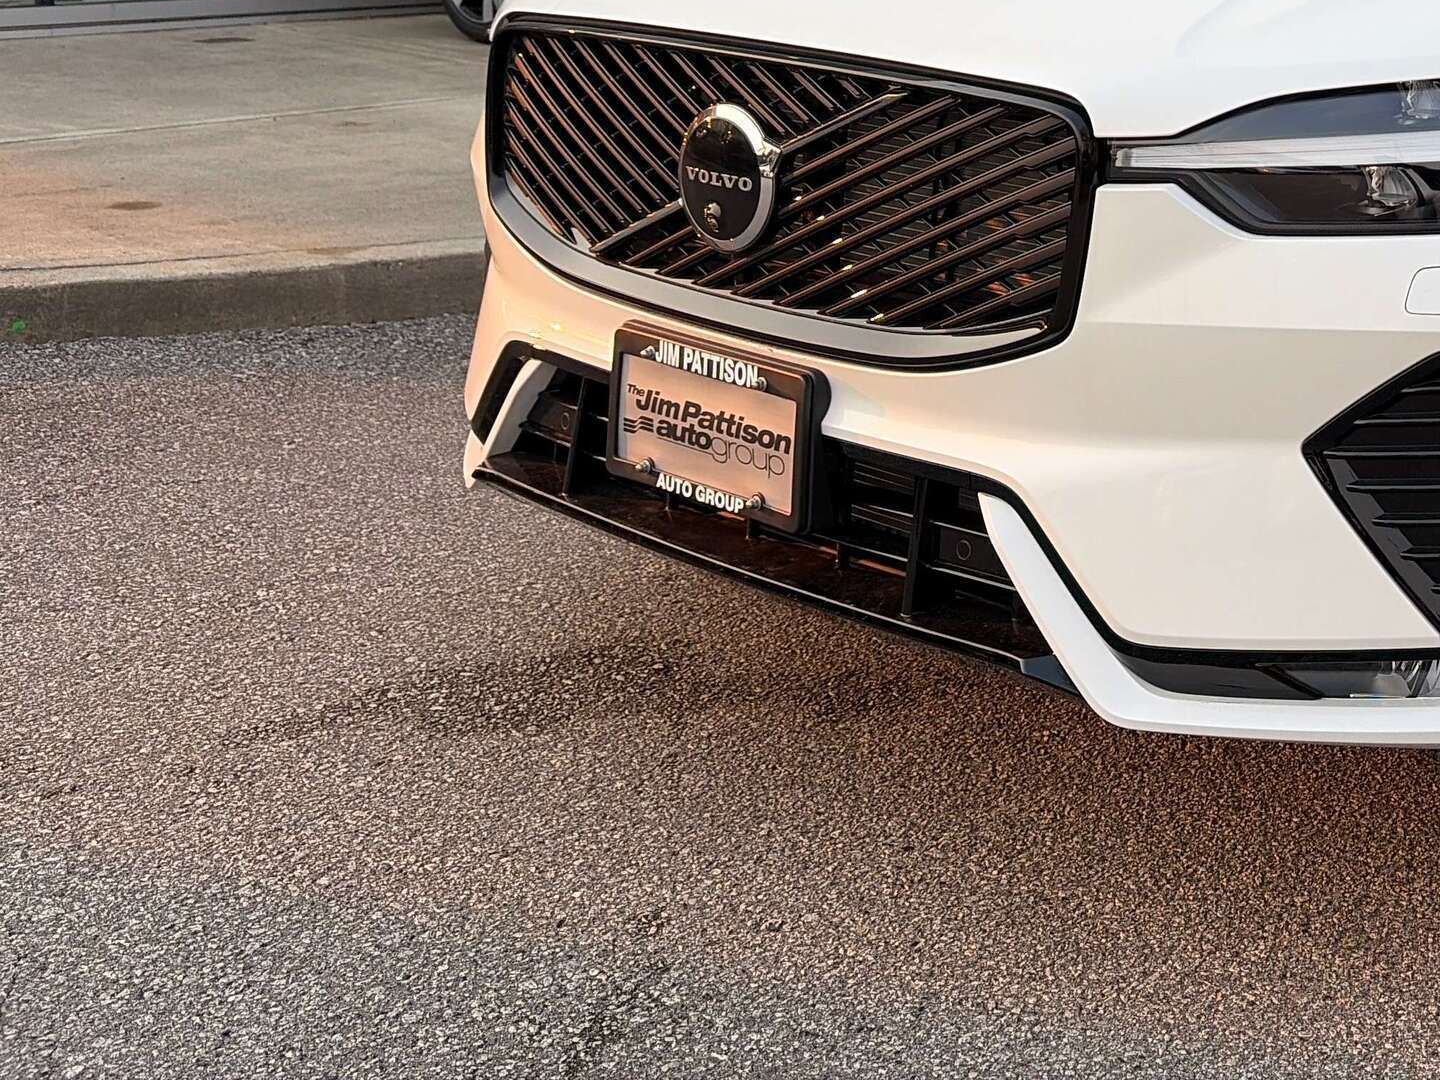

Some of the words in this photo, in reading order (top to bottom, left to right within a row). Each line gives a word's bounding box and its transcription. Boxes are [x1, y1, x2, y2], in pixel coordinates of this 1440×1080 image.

[685, 165, 753, 192] VOLVO
[655, 339, 680, 369] JIM
[683, 349, 759, 388] PATTISON
[627, 383, 646, 397] The
[655, 472, 693, 498] AUTO
[695, 485, 745, 514] GROUP
